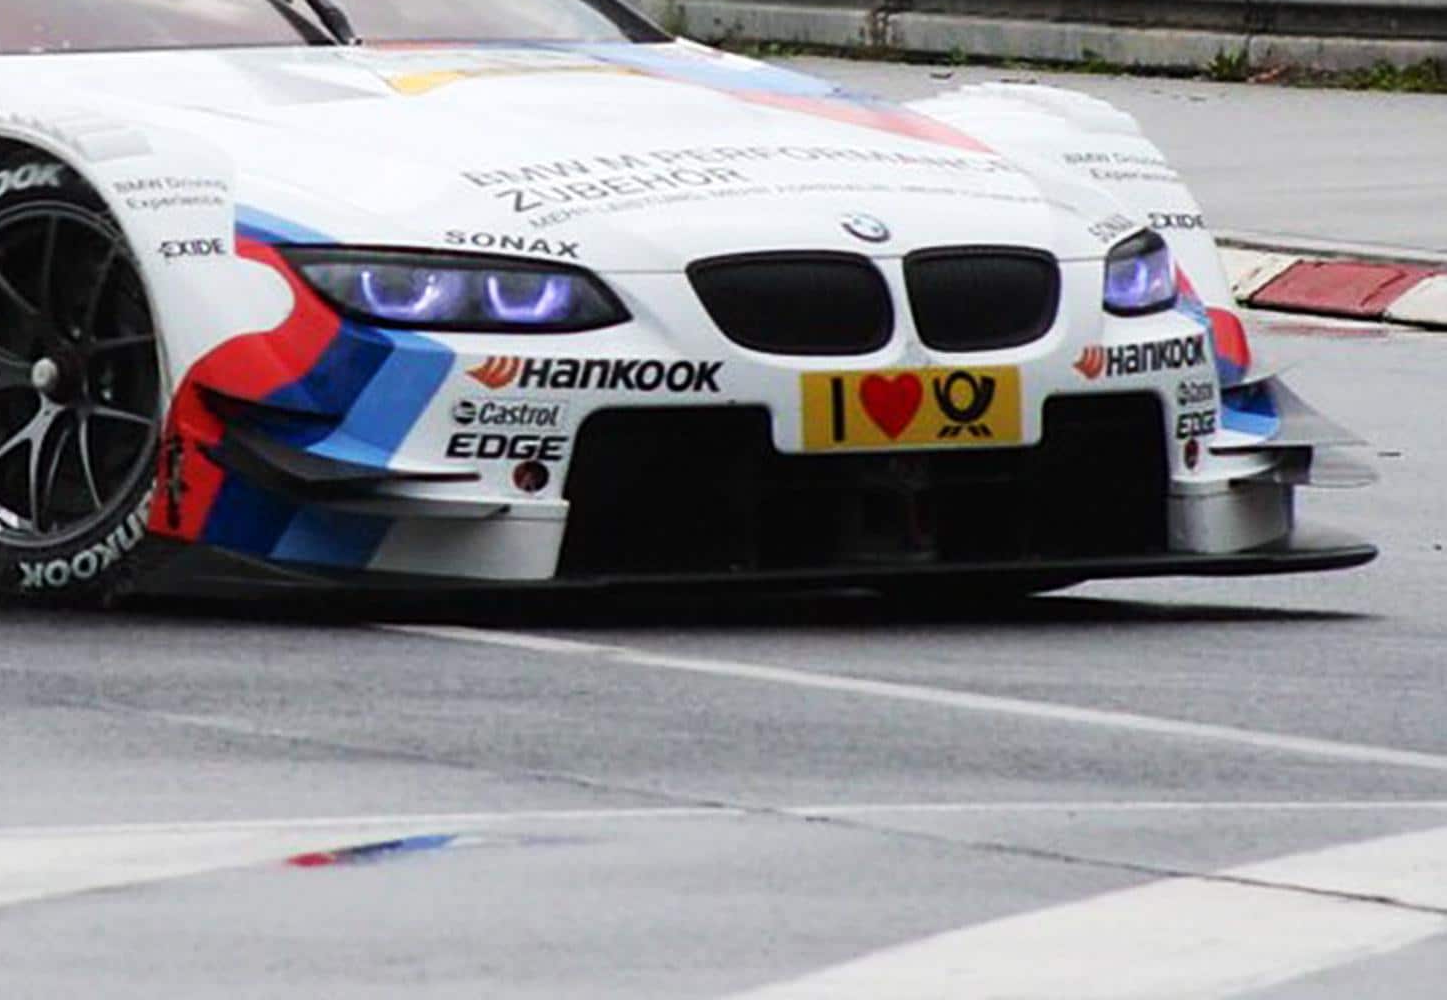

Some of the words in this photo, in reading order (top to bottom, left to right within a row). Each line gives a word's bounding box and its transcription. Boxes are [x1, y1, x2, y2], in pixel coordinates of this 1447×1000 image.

[460, 158, 590, 187] BMW
[444, 229, 580, 258] SONAX
[479, 402, 558, 427] Castrol
[831, 377, 845, 442] I
[445, 433, 569, 460] EDGE
